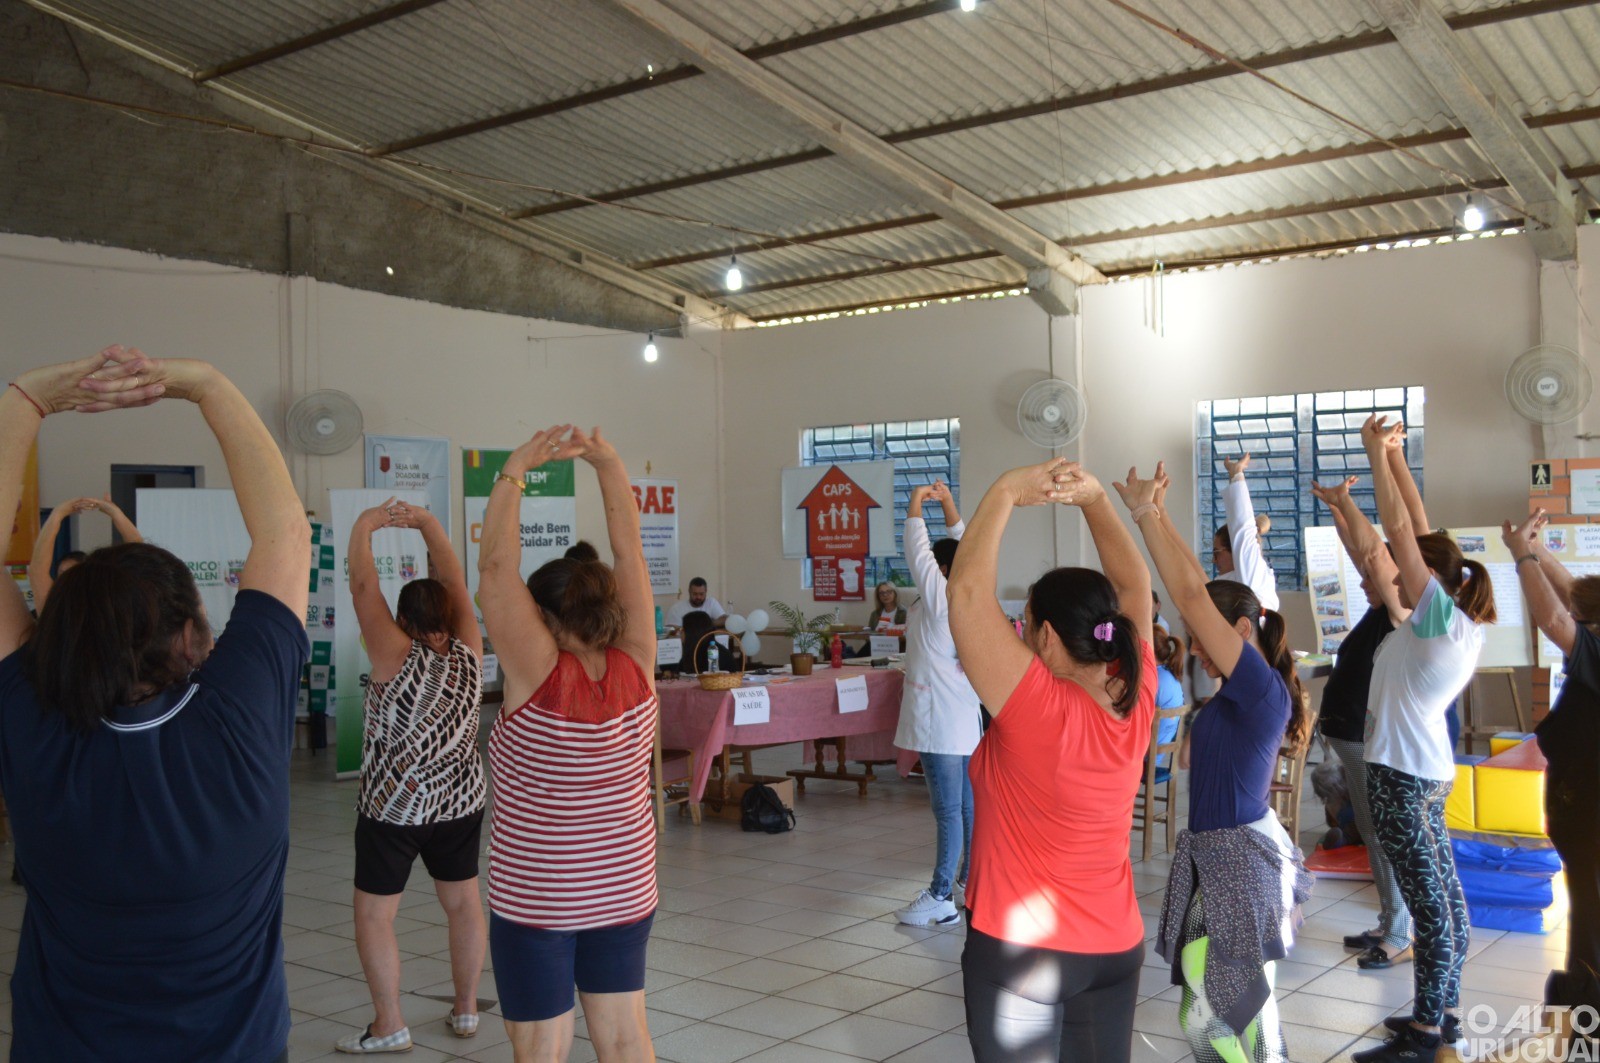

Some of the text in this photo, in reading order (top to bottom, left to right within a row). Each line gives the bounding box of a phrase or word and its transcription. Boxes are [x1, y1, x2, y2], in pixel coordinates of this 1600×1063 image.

[822, 483, 852, 497] CAPS
[519, 523, 571, 534] Rede Bem
[555, 536, 570, 546] RS
[817, 534, 834, 542] Centro
[737, 689, 766, 699] DICAS DE
[742, 700, 763, 710] SAÚDE
